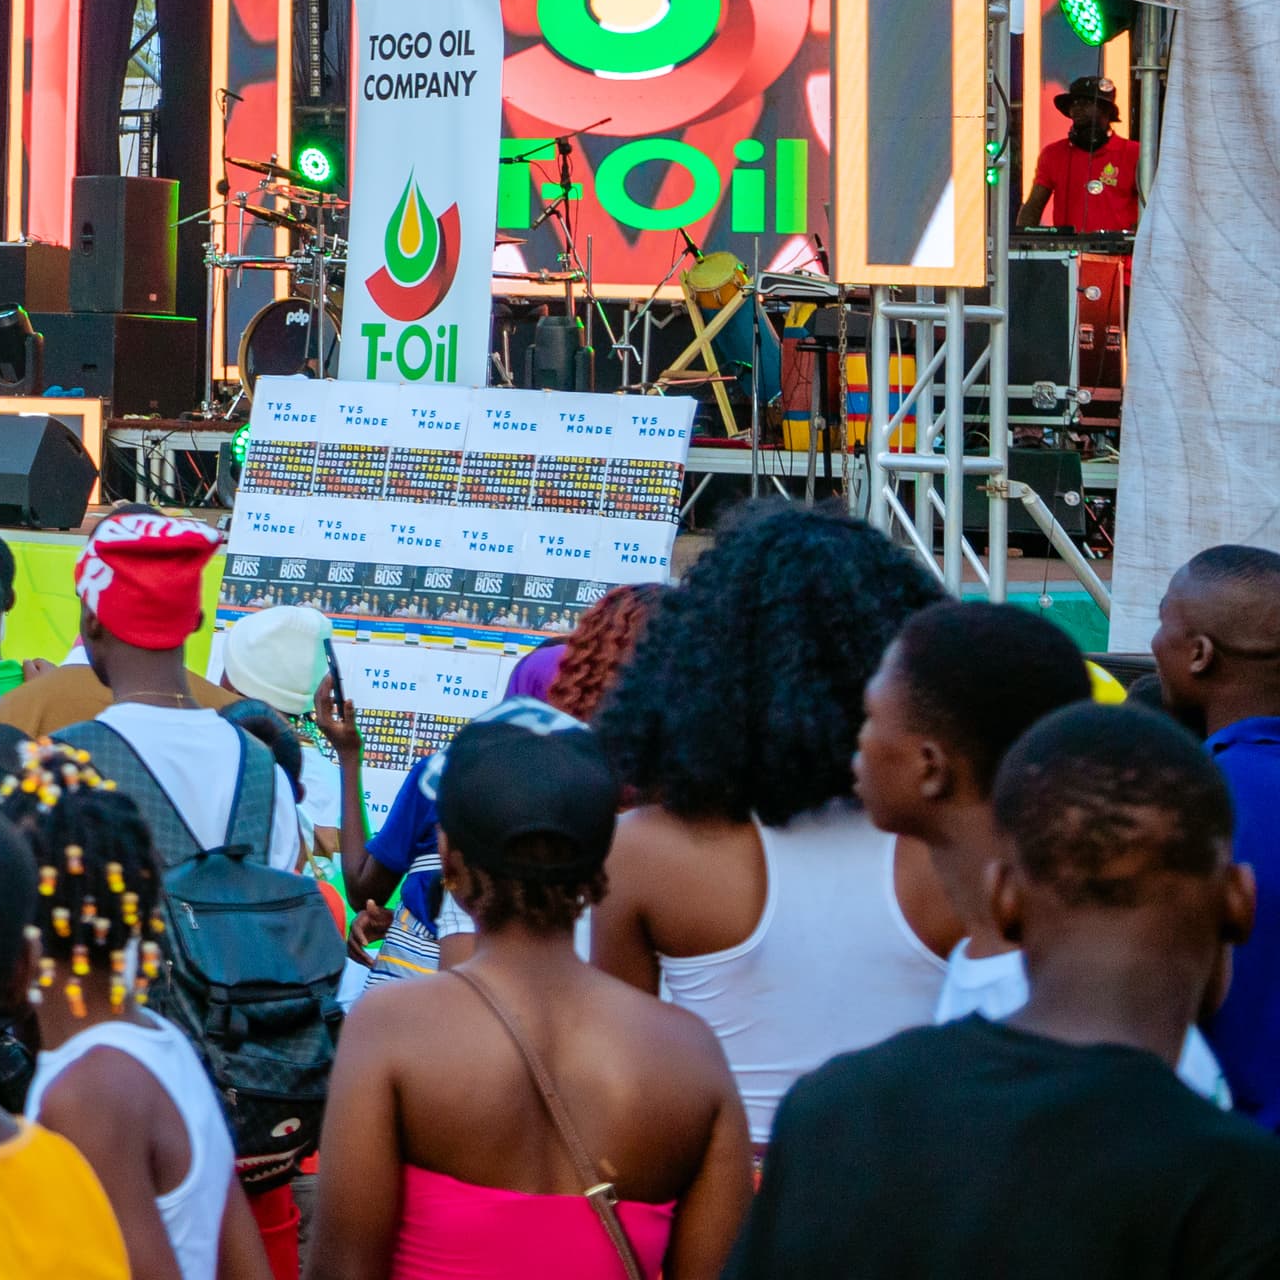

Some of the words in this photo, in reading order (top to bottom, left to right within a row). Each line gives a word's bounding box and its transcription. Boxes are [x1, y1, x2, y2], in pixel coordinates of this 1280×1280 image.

[368, 32, 433, 61] TOGO
[439, 29, 476, 57] OIL
[363, 69, 478, 101] COMPANY
[497, 138, 808, 234] T-Oil
[286, 308, 310, 326] pdp
[361, 323, 458, 383] T-Oil
[267, 402, 292, 411] TV5
[339, 404, 363, 414] TV5
[274, 413, 317, 423] MONDE
[411, 408, 437, 418] TV5
[486, 409, 511, 419] TV5
[559, 412, 585, 423] TV5
[345, 416, 388, 427] MONDE
[418, 420, 461, 431] MONDE
[631, 415, 658, 426] TV5
[492, 421, 538, 432] MONDE
[566, 424, 613, 435] MONDE
[639, 427, 687, 439] MONDE
[247, 511, 271, 521] TV5
[253, 523, 295, 534] MONDE
[318, 519, 342, 529] TV5
[390, 524, 416, 534] TV5
[324, 531, 366, 542] MONDE
[462, 530, 489, 541] TV5
[538, 535, 565, 545] TV5
[397, 535, 442, 548] MONDE
[613, 541, 640, 552] TV5
[469, 542, 514, 554] MONDE
[546, 547, 591, 559] MONDE
[621, 553, 668, 567] MONDE
[231, 560, 260, 576] BOSS
[279, 563, 307, 579] BOSS
[327, 567, 355, 583] BOSS
[373, 569, 403, 586] BOSS
[423, 572, 453, 589] BOSS
[474, 577, 503, 594] BOSS
[523, 581, 554, 599] BOSS
[364, 668, 390, 678] TV5
[436, 673, 462, 685] TV5
[372, 680, 417, 691] MONDE
[442, 686, 489, 700] MONDE
